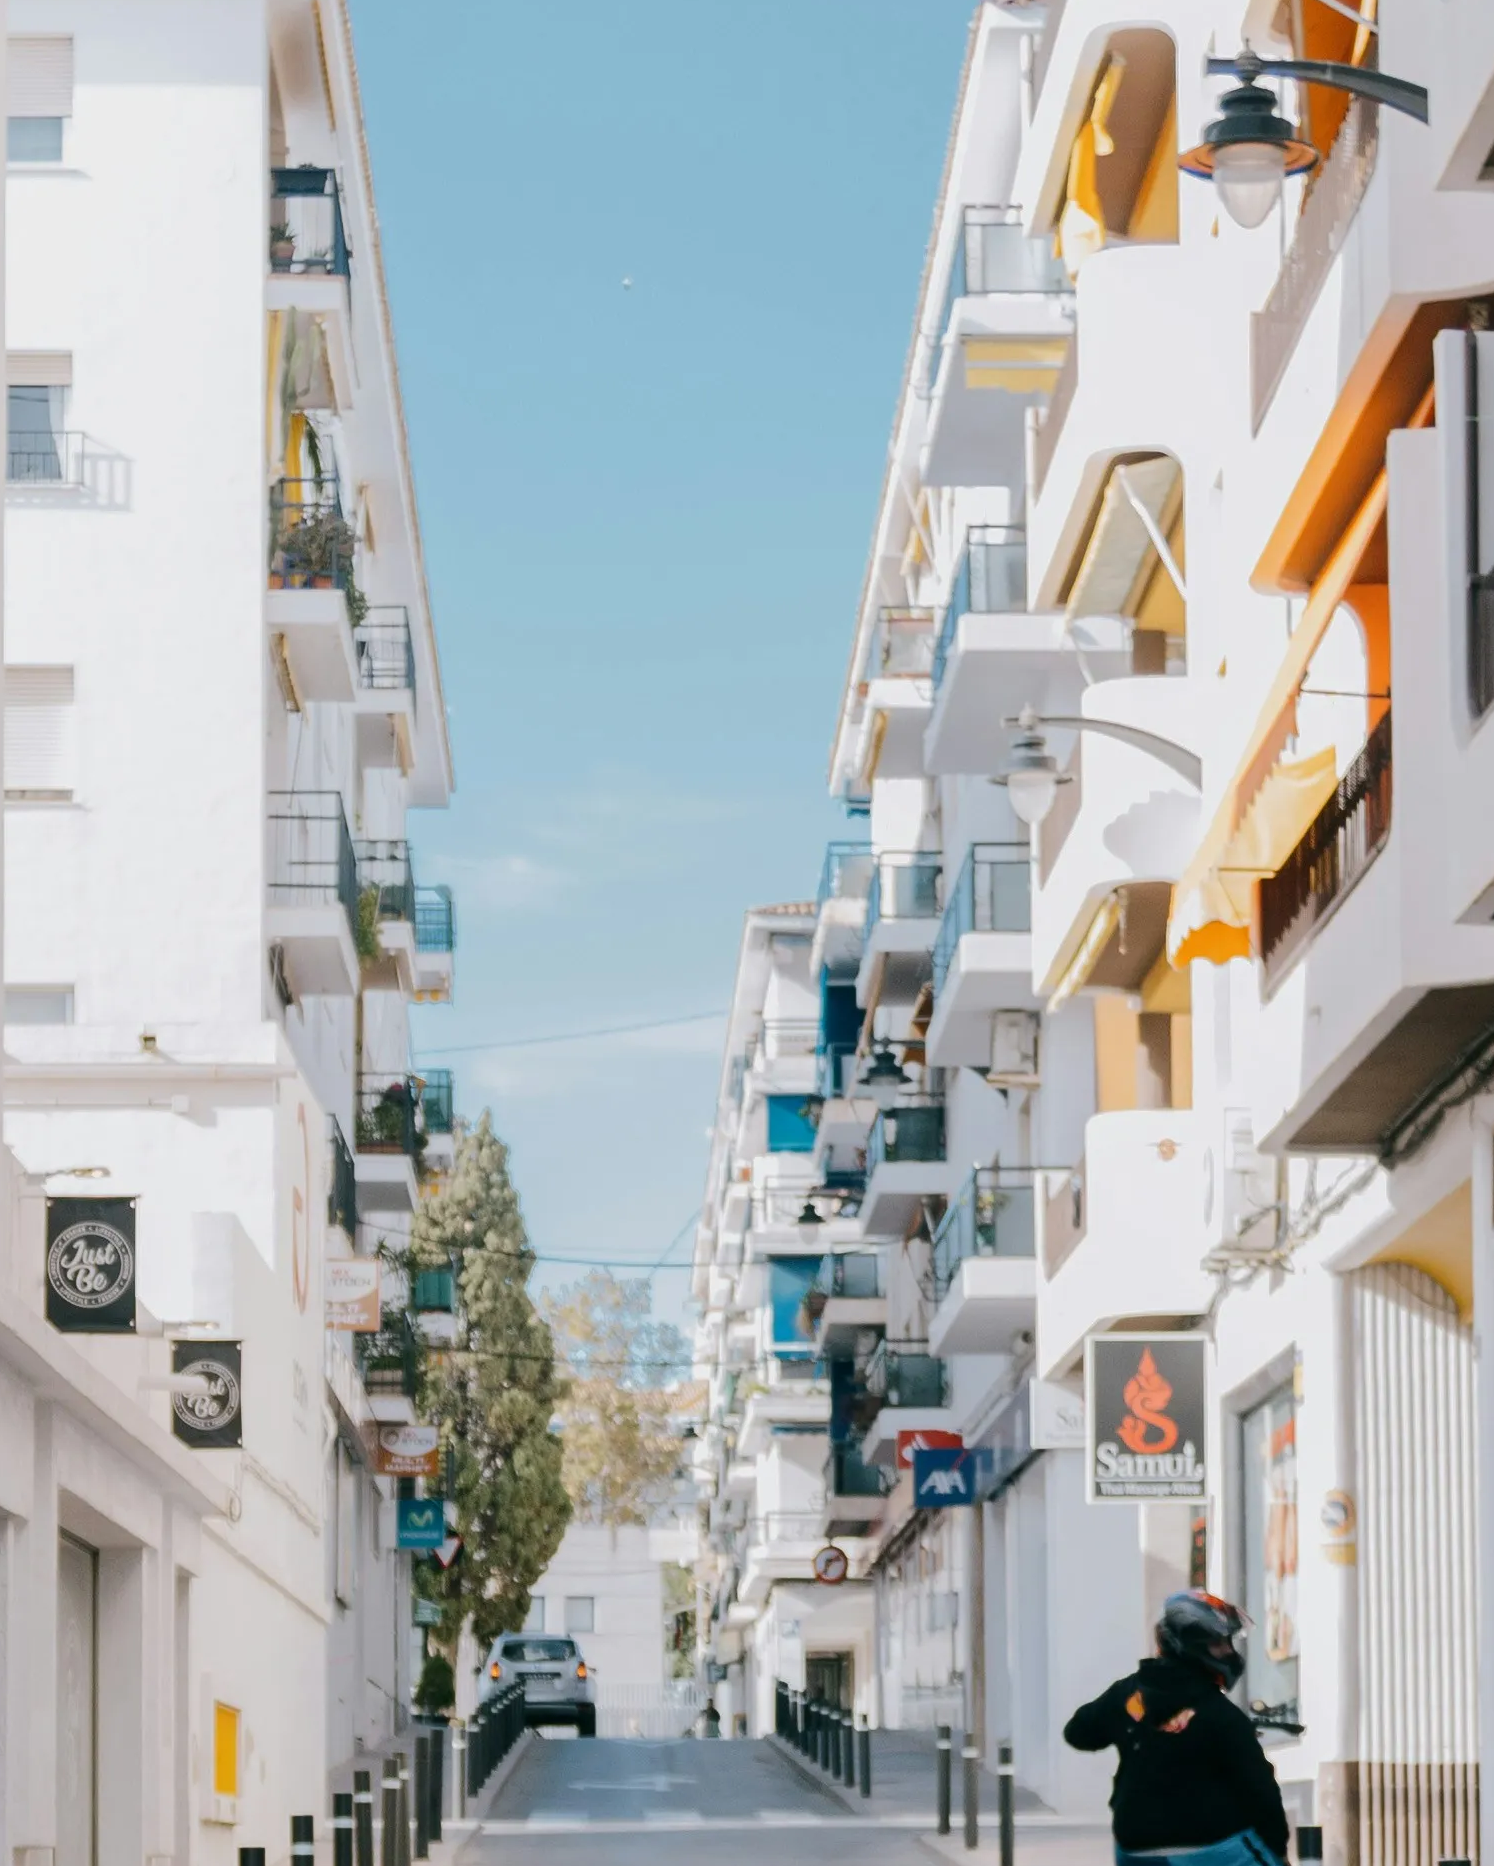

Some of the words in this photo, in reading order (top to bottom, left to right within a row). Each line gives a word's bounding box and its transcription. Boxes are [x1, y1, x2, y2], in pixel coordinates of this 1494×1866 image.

[61, 1239, 116, 1268] Just
[66, 1264, 108, 1293] Be
[1096, 1439, 1197, 1479] Samui
[919, 1469, 967, 1495] AXA
